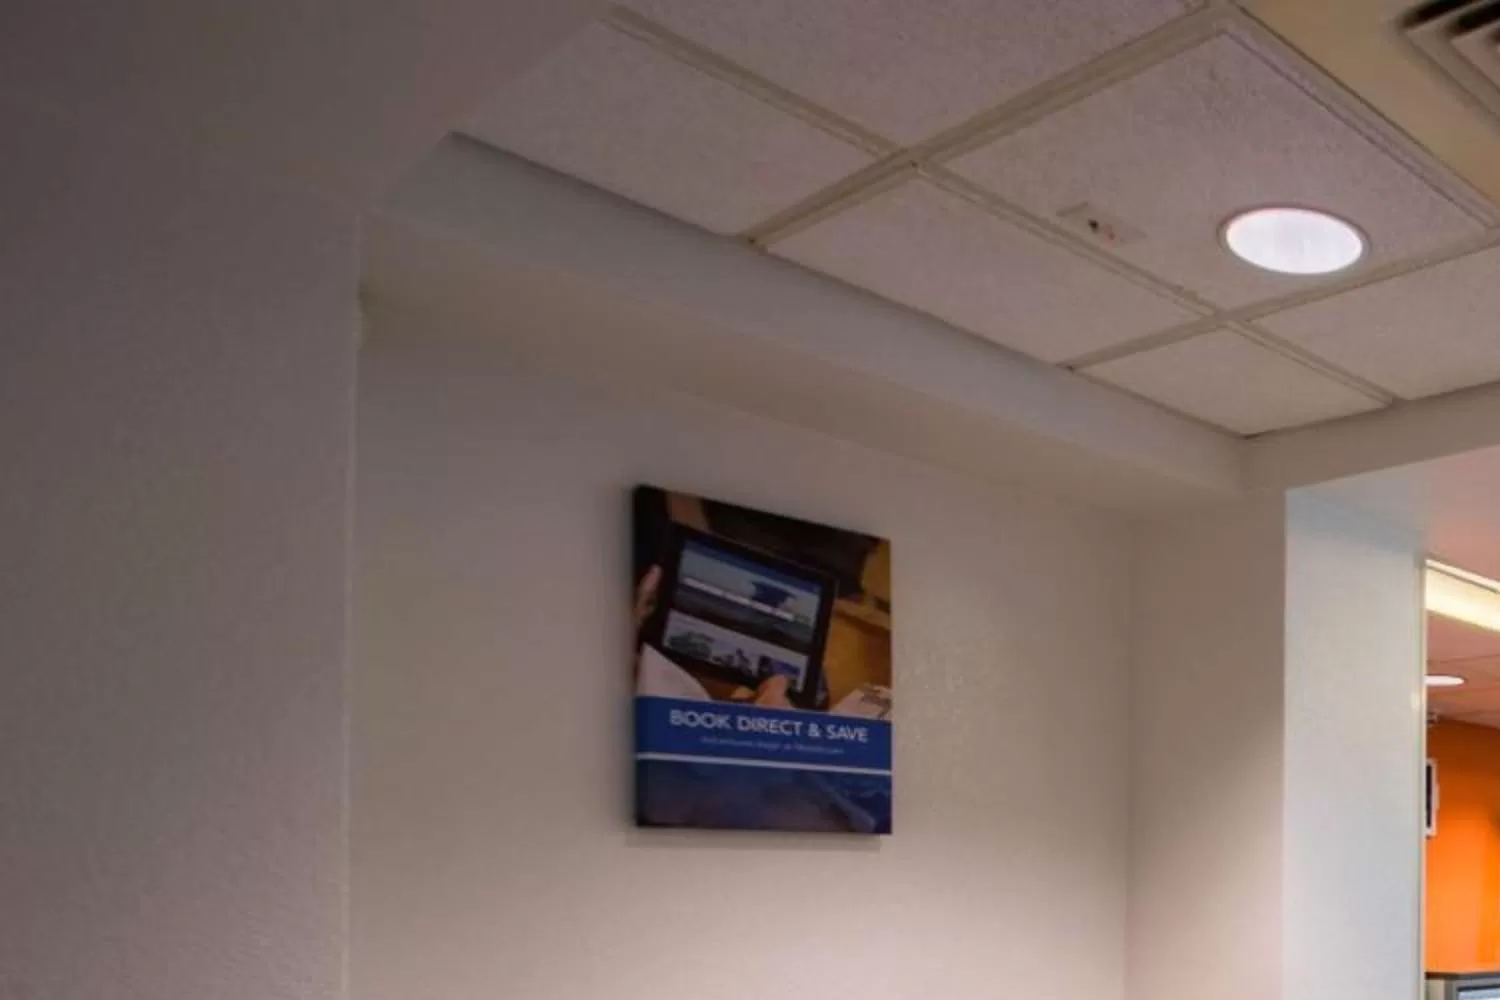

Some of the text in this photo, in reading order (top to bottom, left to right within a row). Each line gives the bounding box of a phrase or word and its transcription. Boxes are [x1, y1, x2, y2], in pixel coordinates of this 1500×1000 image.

[670, 710, 869, 743] BOOK DIRECT & SAVE
